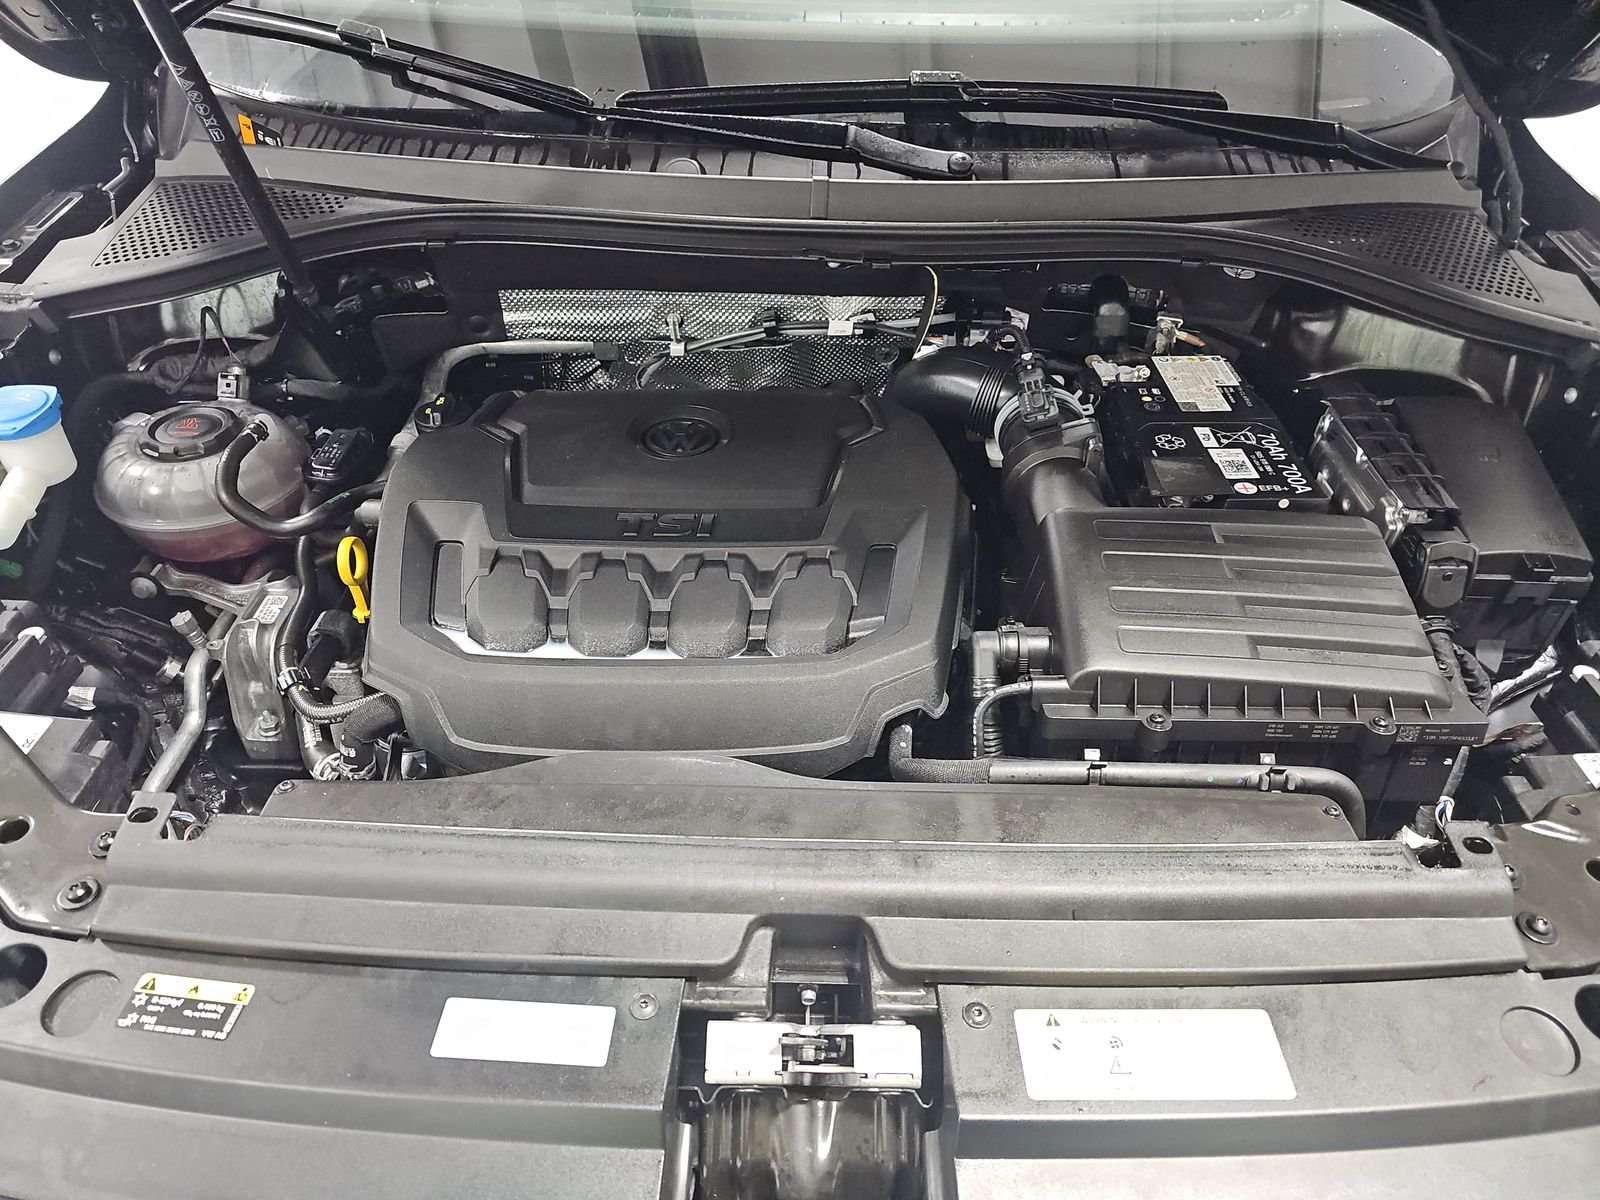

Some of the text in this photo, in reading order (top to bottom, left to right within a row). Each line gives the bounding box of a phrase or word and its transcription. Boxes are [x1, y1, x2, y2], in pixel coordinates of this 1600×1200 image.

[1199, 432, 1211, 442] Pb
[1257, 432, 1288, 460] 70Ah
[1278, 463, 1312, 494] 700A
[1258, 484, 1290, 492] EFB+
[616, 512, 718, 537] TSI
